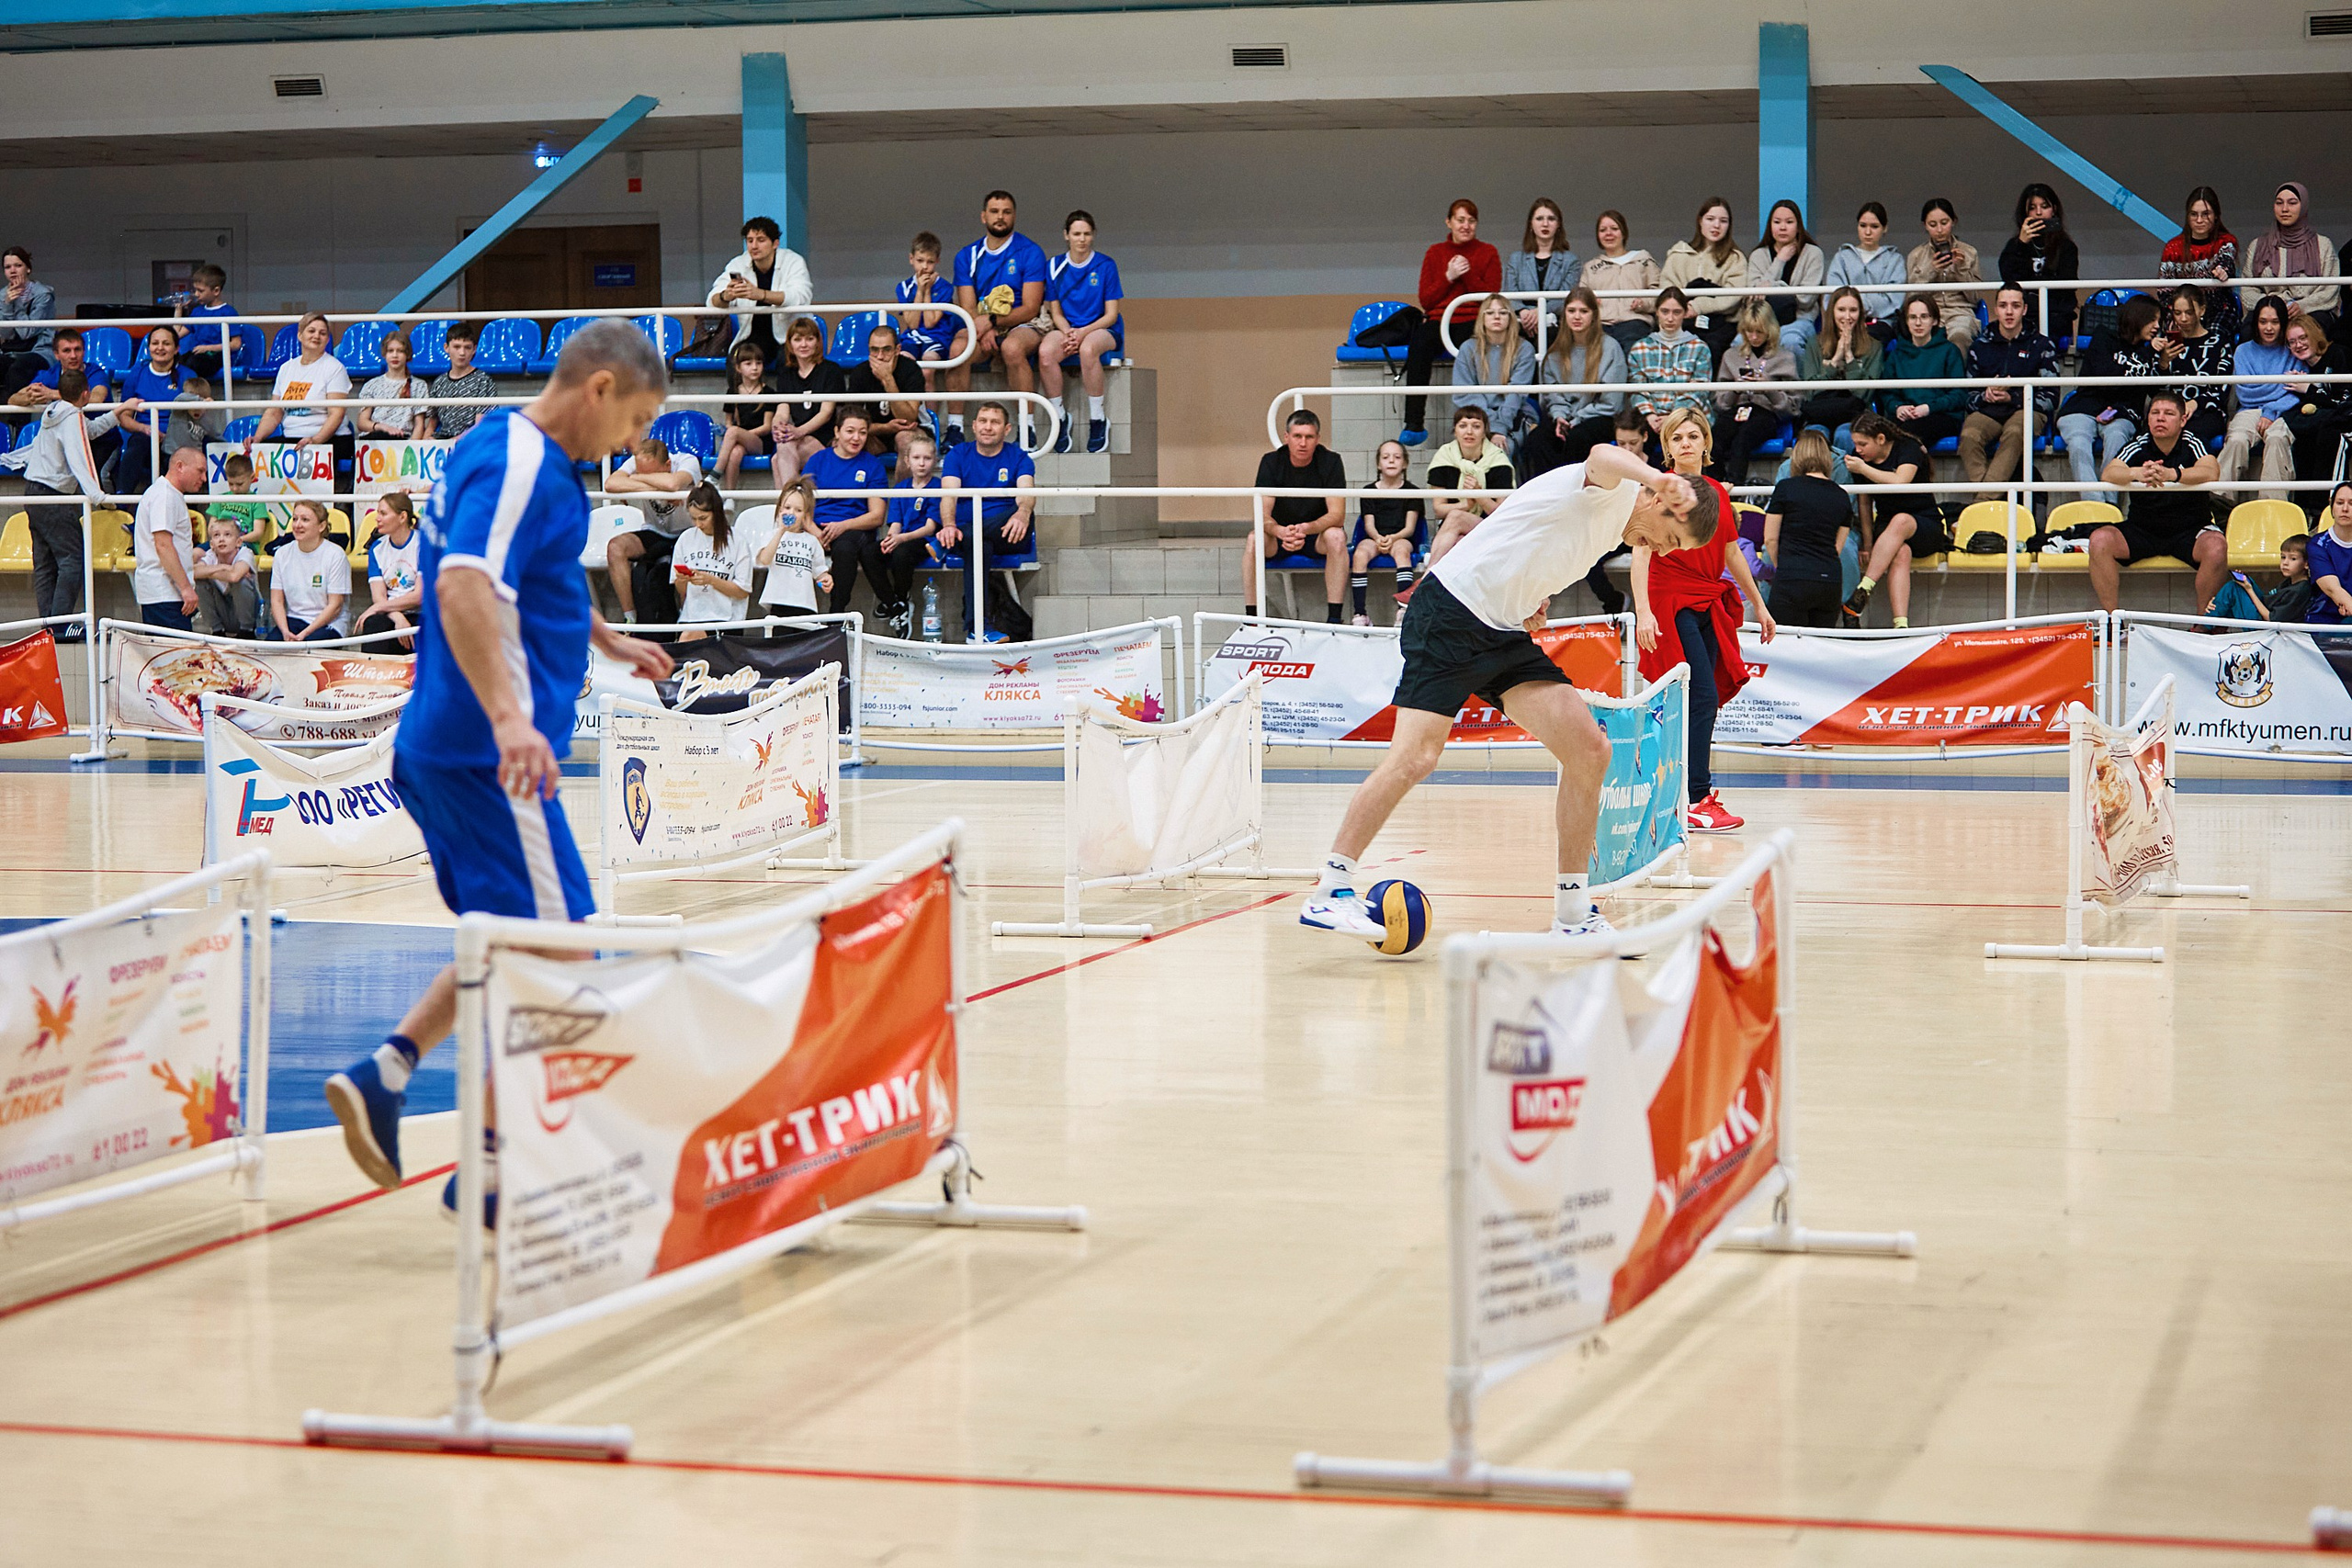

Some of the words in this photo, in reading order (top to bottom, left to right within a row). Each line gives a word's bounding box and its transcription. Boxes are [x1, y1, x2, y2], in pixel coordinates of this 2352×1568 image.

[209, 444, 334, 483] ХАКОВЫ
[356, 445, 451, 484] ХОДАКО
[684, 551, 734, 570] СБОРНАЯ
[776, 553, 812, 569] КРАКОВ
[1114, 641, 1152, 652] ПЕЧАТАЕМ
[1220, 646, 1281, 658] SPORT
[876, 649, 899, 658] Набор
[1053, 649, 1101, 658] ФРЕЗЕРУЕМ
[1254, 663, 1307, 676] МОДА
[984, 690, 1041, 701] КЛЯКСА
[2221, 692, 2269, 705] ТЮМЕНЬ
[303, 697, 331, 709] Заказ
[861, 703, 911, 711] -800-3333-094
[1860, 705, 2045, 724] ХЕТ-ТРИК
[298, 726, 356, 740] 788-688
[2137, 719, 2351, 743] ww.mfktyumen.ru
[684, 745, 702, 757] Набор
[337, 778, 401, 819] «РЕГИ
[249, 817, 275, 836] МЕД
[703, 1069, 921, 1189] ХЕТ-ТРИК
